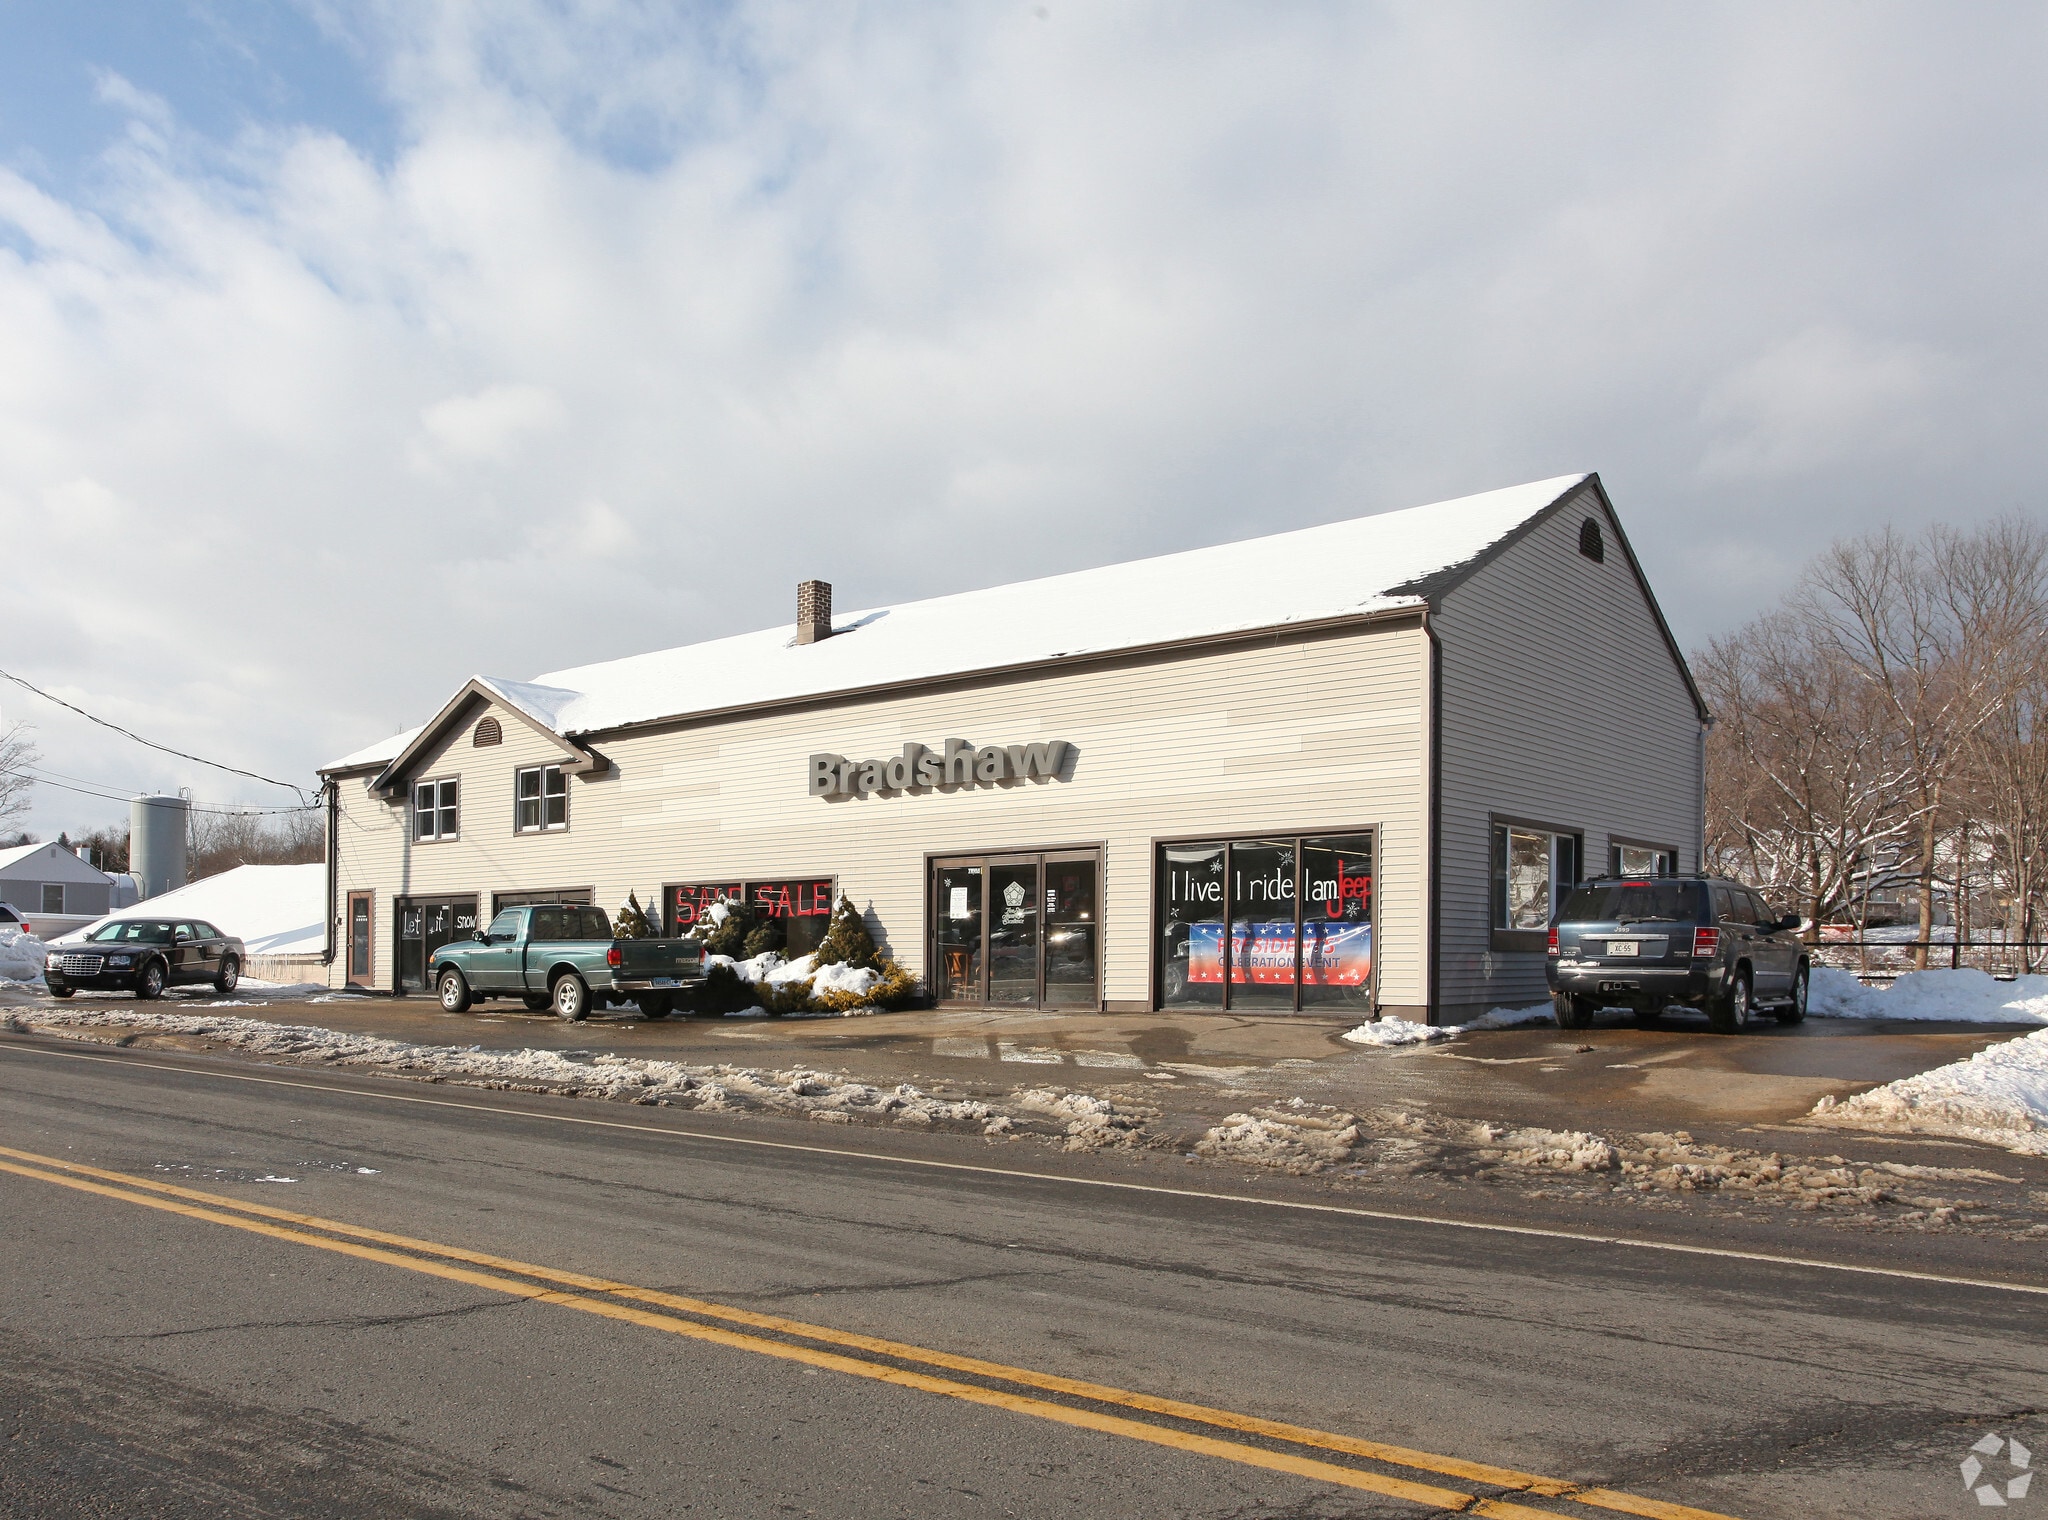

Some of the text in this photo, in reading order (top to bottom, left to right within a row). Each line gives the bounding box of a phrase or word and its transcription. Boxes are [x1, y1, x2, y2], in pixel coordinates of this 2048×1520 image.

[809, 738, 1069, 797] Bradshaw
[756, 882, 830, 918] SALE
[1172, 870, 1176, 901] I
[1184, 870, 1224, 902] live.
[1236, 870, 1241, 901] I
[1249, 867, 1296, 901] ride.
[1305, 868, 1309, 902] I
[1326, 859, 1372, 919] Jeep
[403, 910, 421, 935] Let
[435, 910, 444, 932] it
[1218, 956, 1296, 968] CLEBRATION
